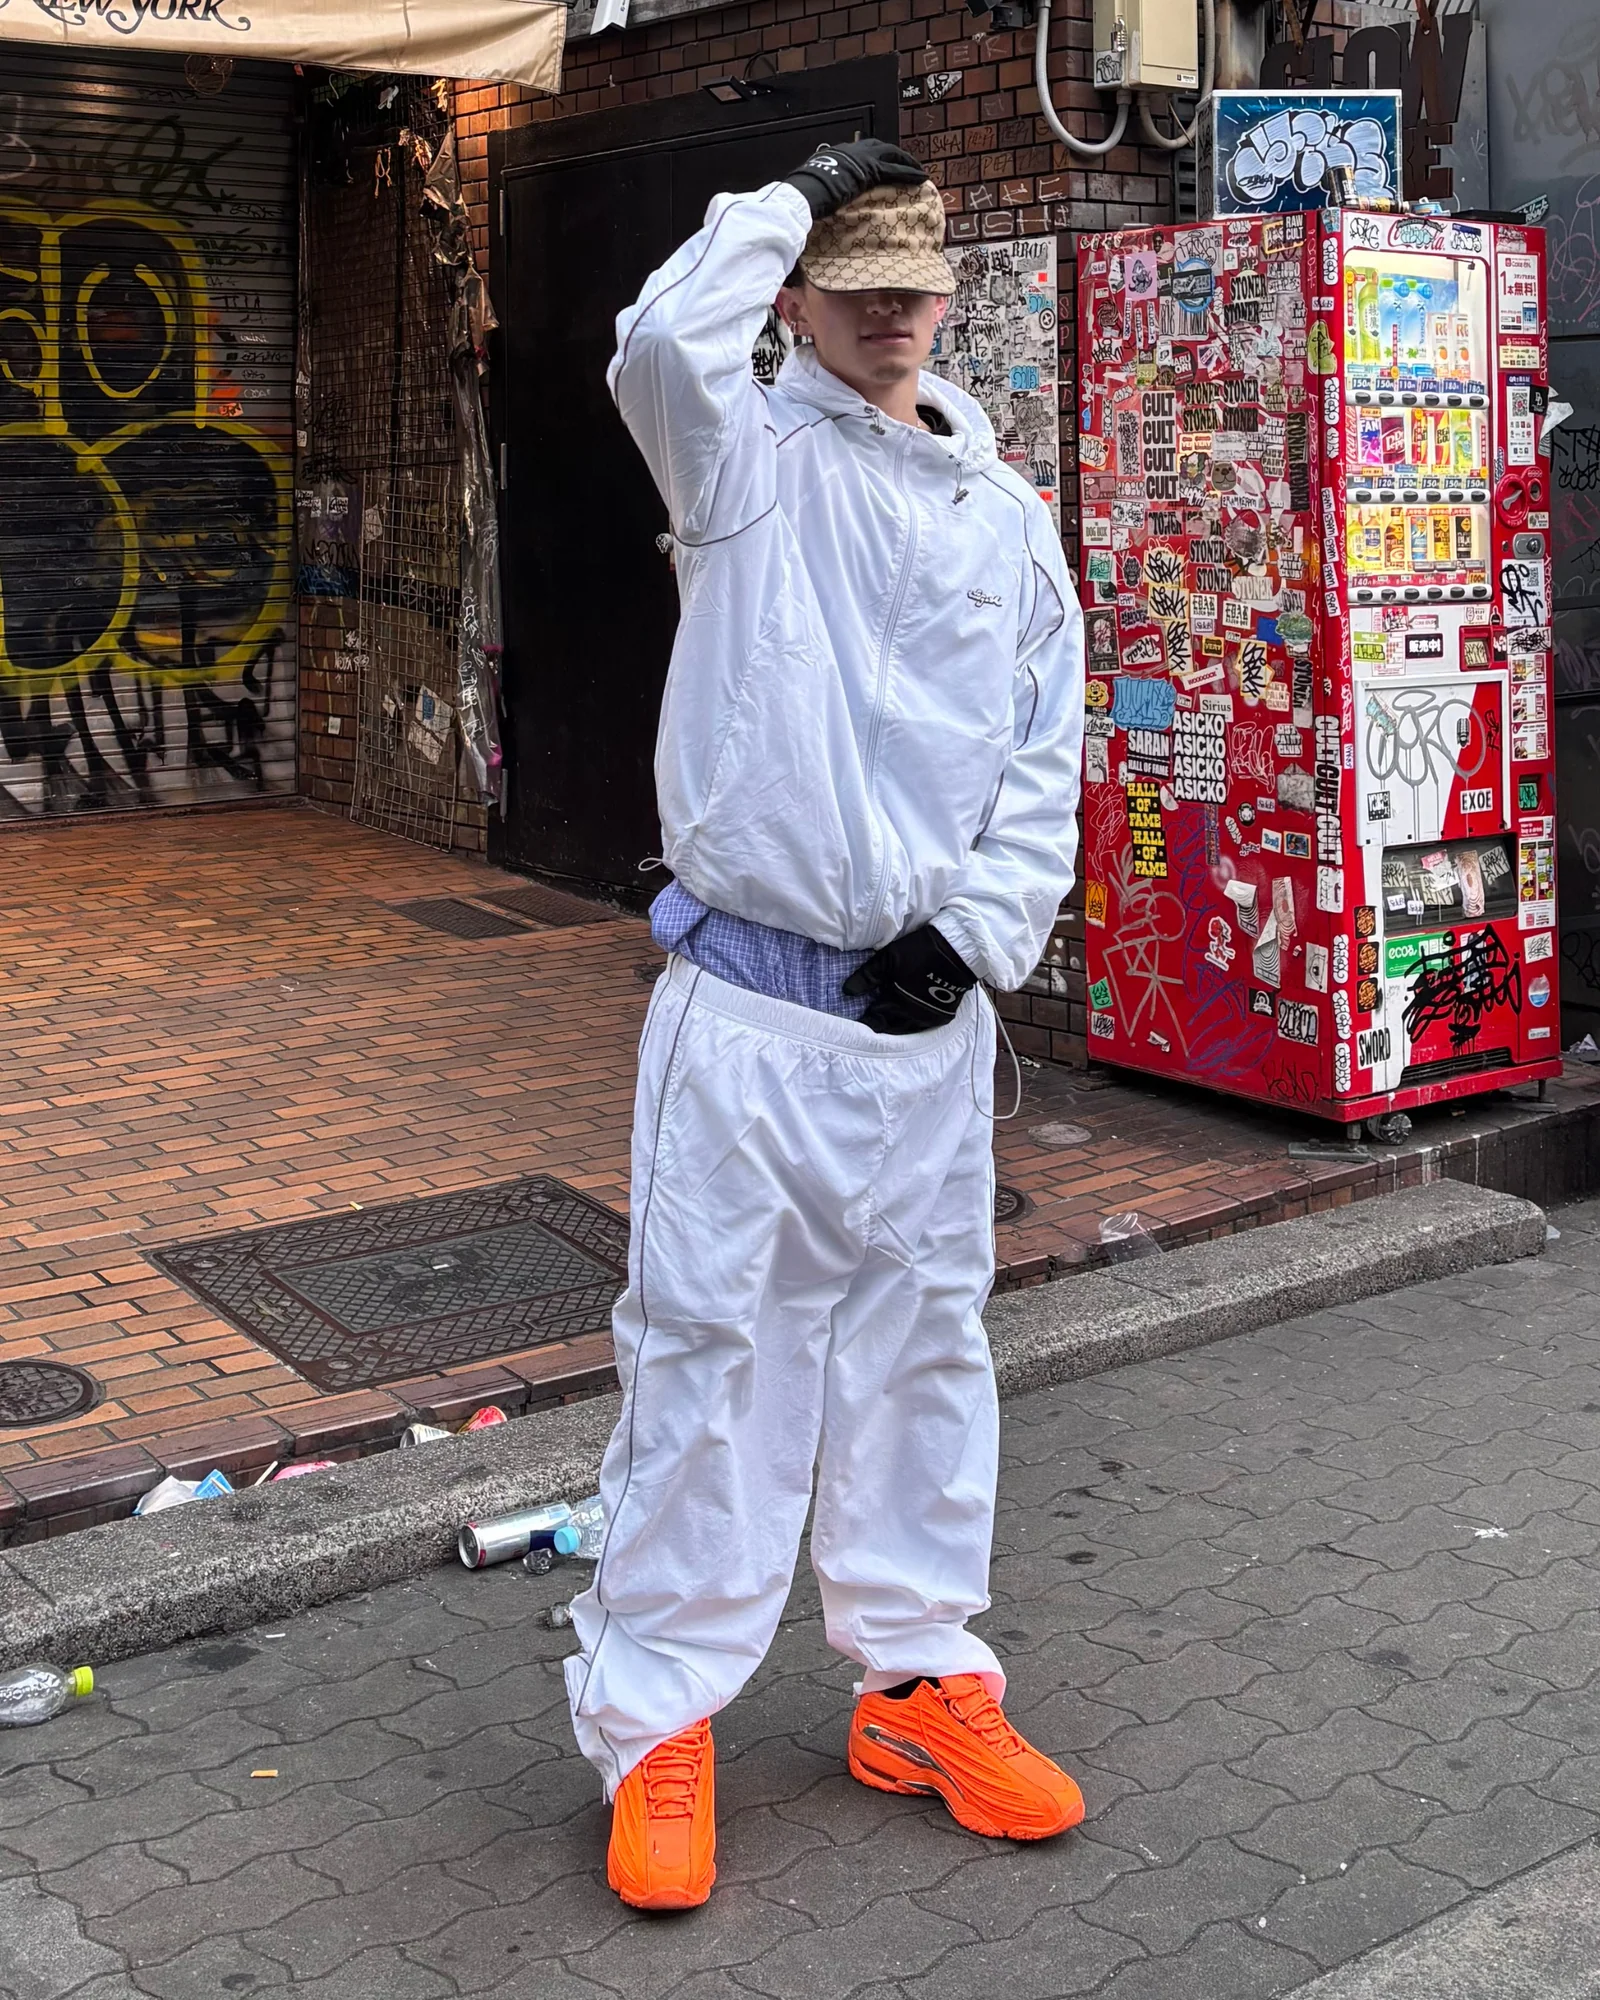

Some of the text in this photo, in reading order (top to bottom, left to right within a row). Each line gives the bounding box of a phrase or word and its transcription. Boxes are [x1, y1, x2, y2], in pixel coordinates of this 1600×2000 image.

[1285, 215, 1303, 227] RAW
[1285, 227, 1304, 240] CULT
[1231, 274, 1267, 300] STONER
[1142, 393, 1175, 417] CULT
[1142, 420, 1175, 444] CULT
[1143, 447, 1176, 472] CULT
[1145, 475, 1178, 500] CULT
[1189, 540, 1226, 563] STONER
[1279, 561, 1302, 571] PAINT
[1196, 567, 1233, 592] STONER
[1202, 699, 1231, 712] Sirius
[1172, 711, 1225, 736] ASICKO
[1128, 730, 1170, 756] SARAN
[1173, 735, 1226, 759] ASICKO
[1275, 734, 1302, 745] PAINT
[1279, 744, 1301, 755] CLUB
[1315, 715, 1341, 763] CULT
[1128, 759, 1169, 776] HALL OF FAME
[1174, 759, 1226, 781] ASICKO
[1127, 783, 1159, 797] HALL
[1174, 778, 1227, 803] ASICKO
[1316, 764, 1341, 814] CULT
[1136, 798, 1150, 811] OF
[1461, 790, 1492, 811] EXOE
[1129, 813, 1161, 828] FAME
[1133, 831, 1165, 846] HALL
[1316, 815, 1343, 865] CULT
[1142, 846, 1157, 859] OF
[1135, 860, 1168, 876] FAME
[1359, 1027, 1392, 1068] SWORD
